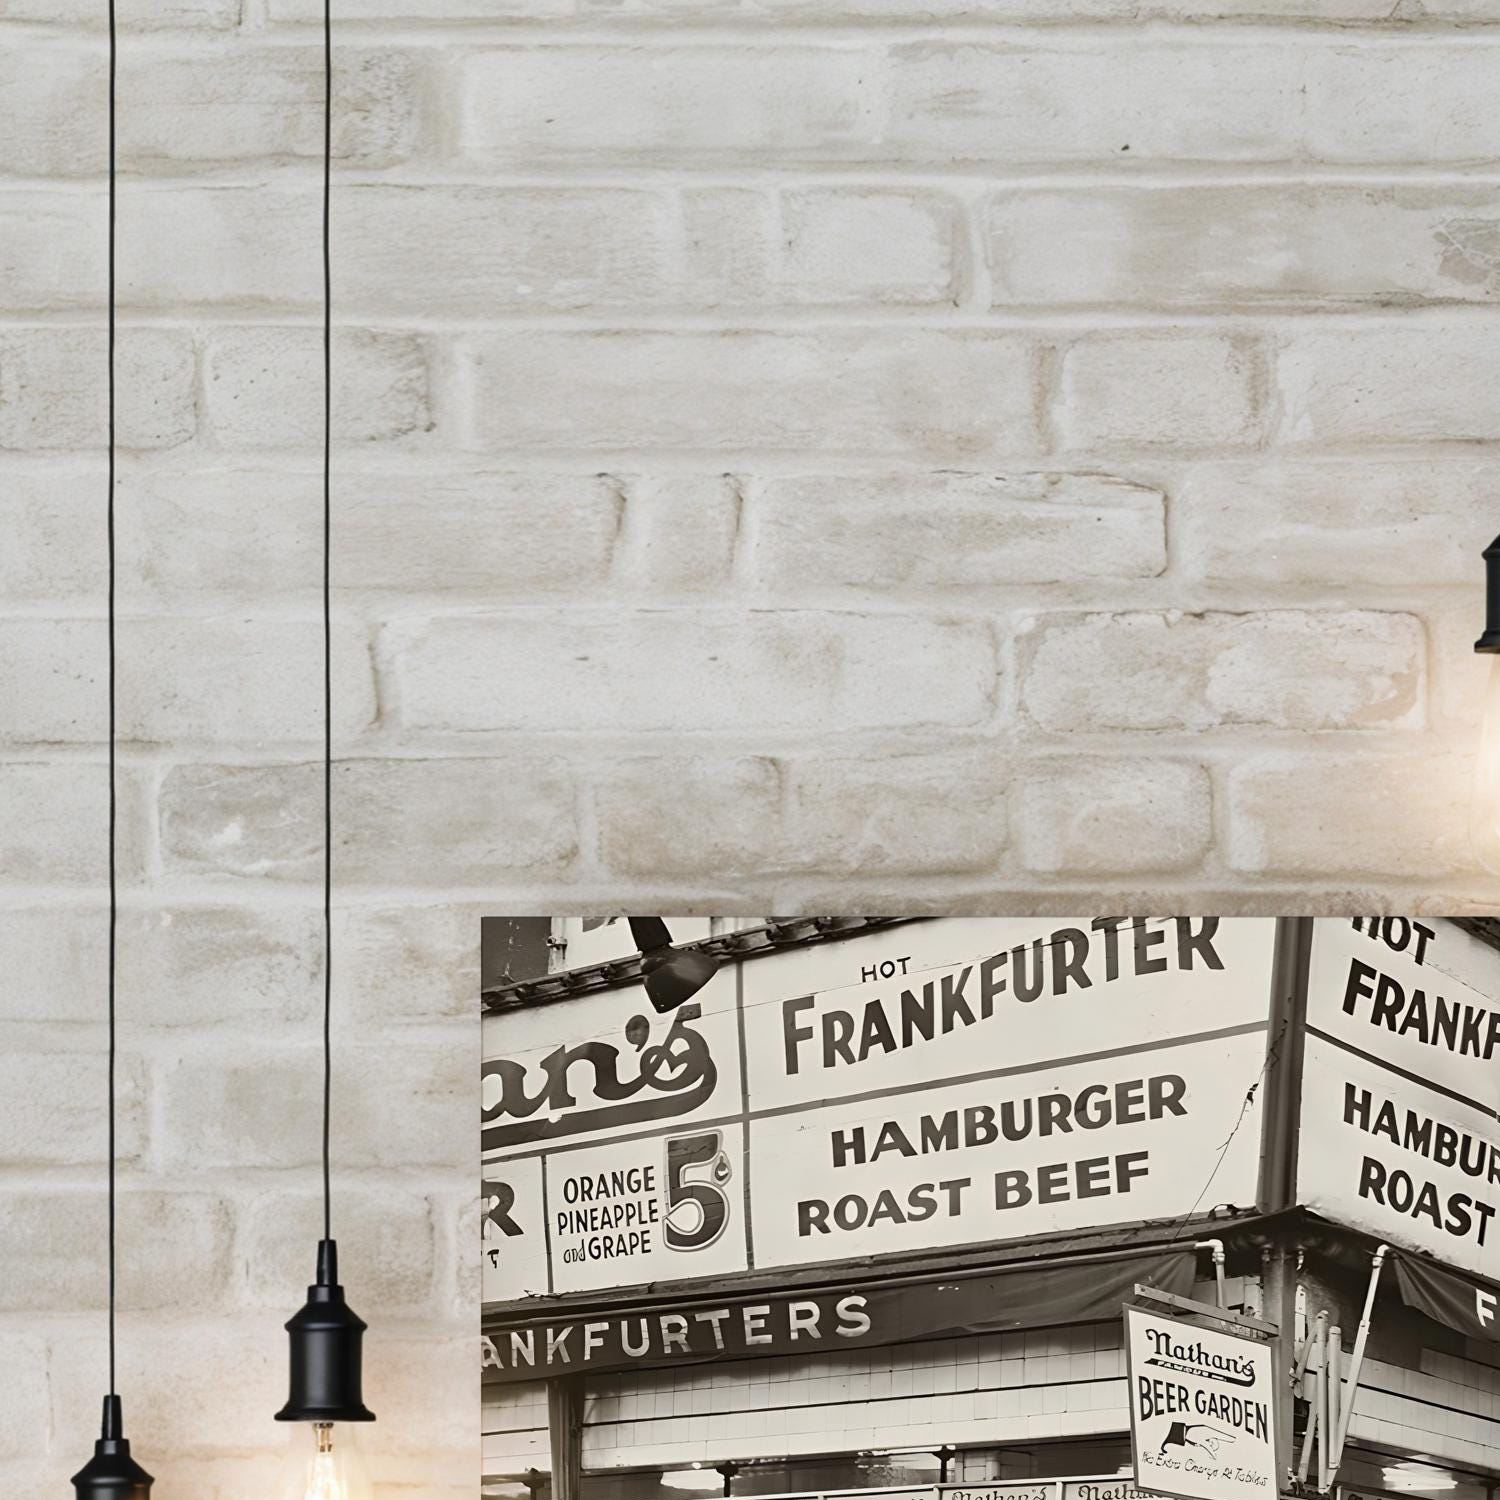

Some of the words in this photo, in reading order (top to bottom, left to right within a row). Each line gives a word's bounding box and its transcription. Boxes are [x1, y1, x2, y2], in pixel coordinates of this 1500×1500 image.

[783, 917, 1225, 1075] FRANKFURTER
[861, 957, 911, 984] HOT
[831, 1075, 1188, 1168] HAMBURGER
[563, 1165, 655, 1204] ORANGE
[798, 1177, 971, 1237] ROAST
[994, 1151, 1149, 1211] BEEF
[1358, 1155, 1496, 1247] ROAST
[557, 1198, 659, 1236] PINEAPPLE
[588, 1230, 652, 1261] GRAPE
[1145, 1328, 1255, 1377] Nathan's
[1138, 1375, 1190, 1421] BEER
[1194, 1390, 1268, 1444] GARDEN
